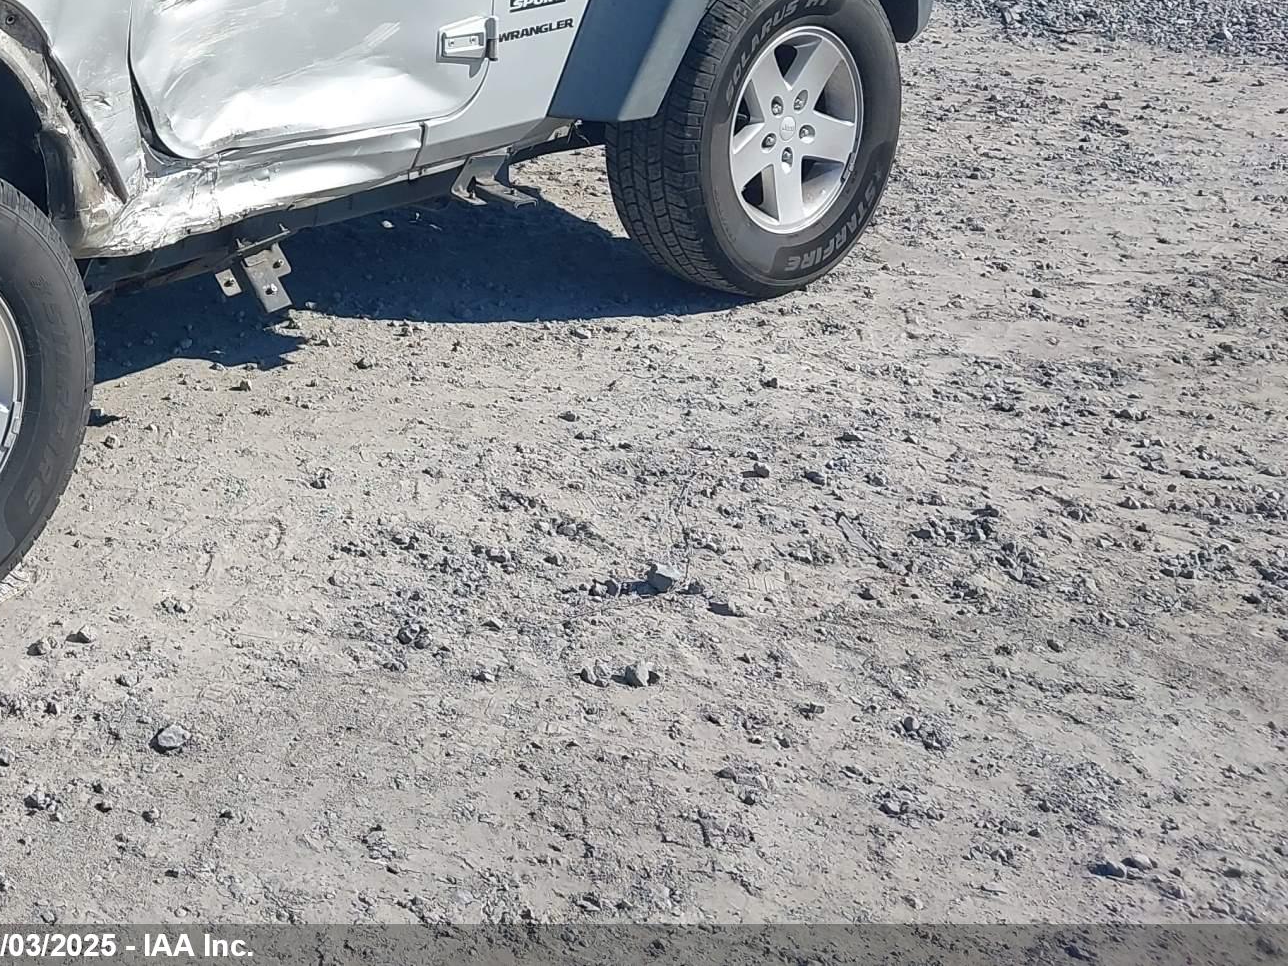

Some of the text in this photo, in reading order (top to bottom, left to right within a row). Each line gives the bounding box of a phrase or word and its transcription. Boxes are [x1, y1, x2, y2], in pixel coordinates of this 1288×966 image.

[499, 18, 574, 43] WRANGLER
[726, 0, 800, 106] SOLARUS
[784, 179, 877, 272] STARFIRE
